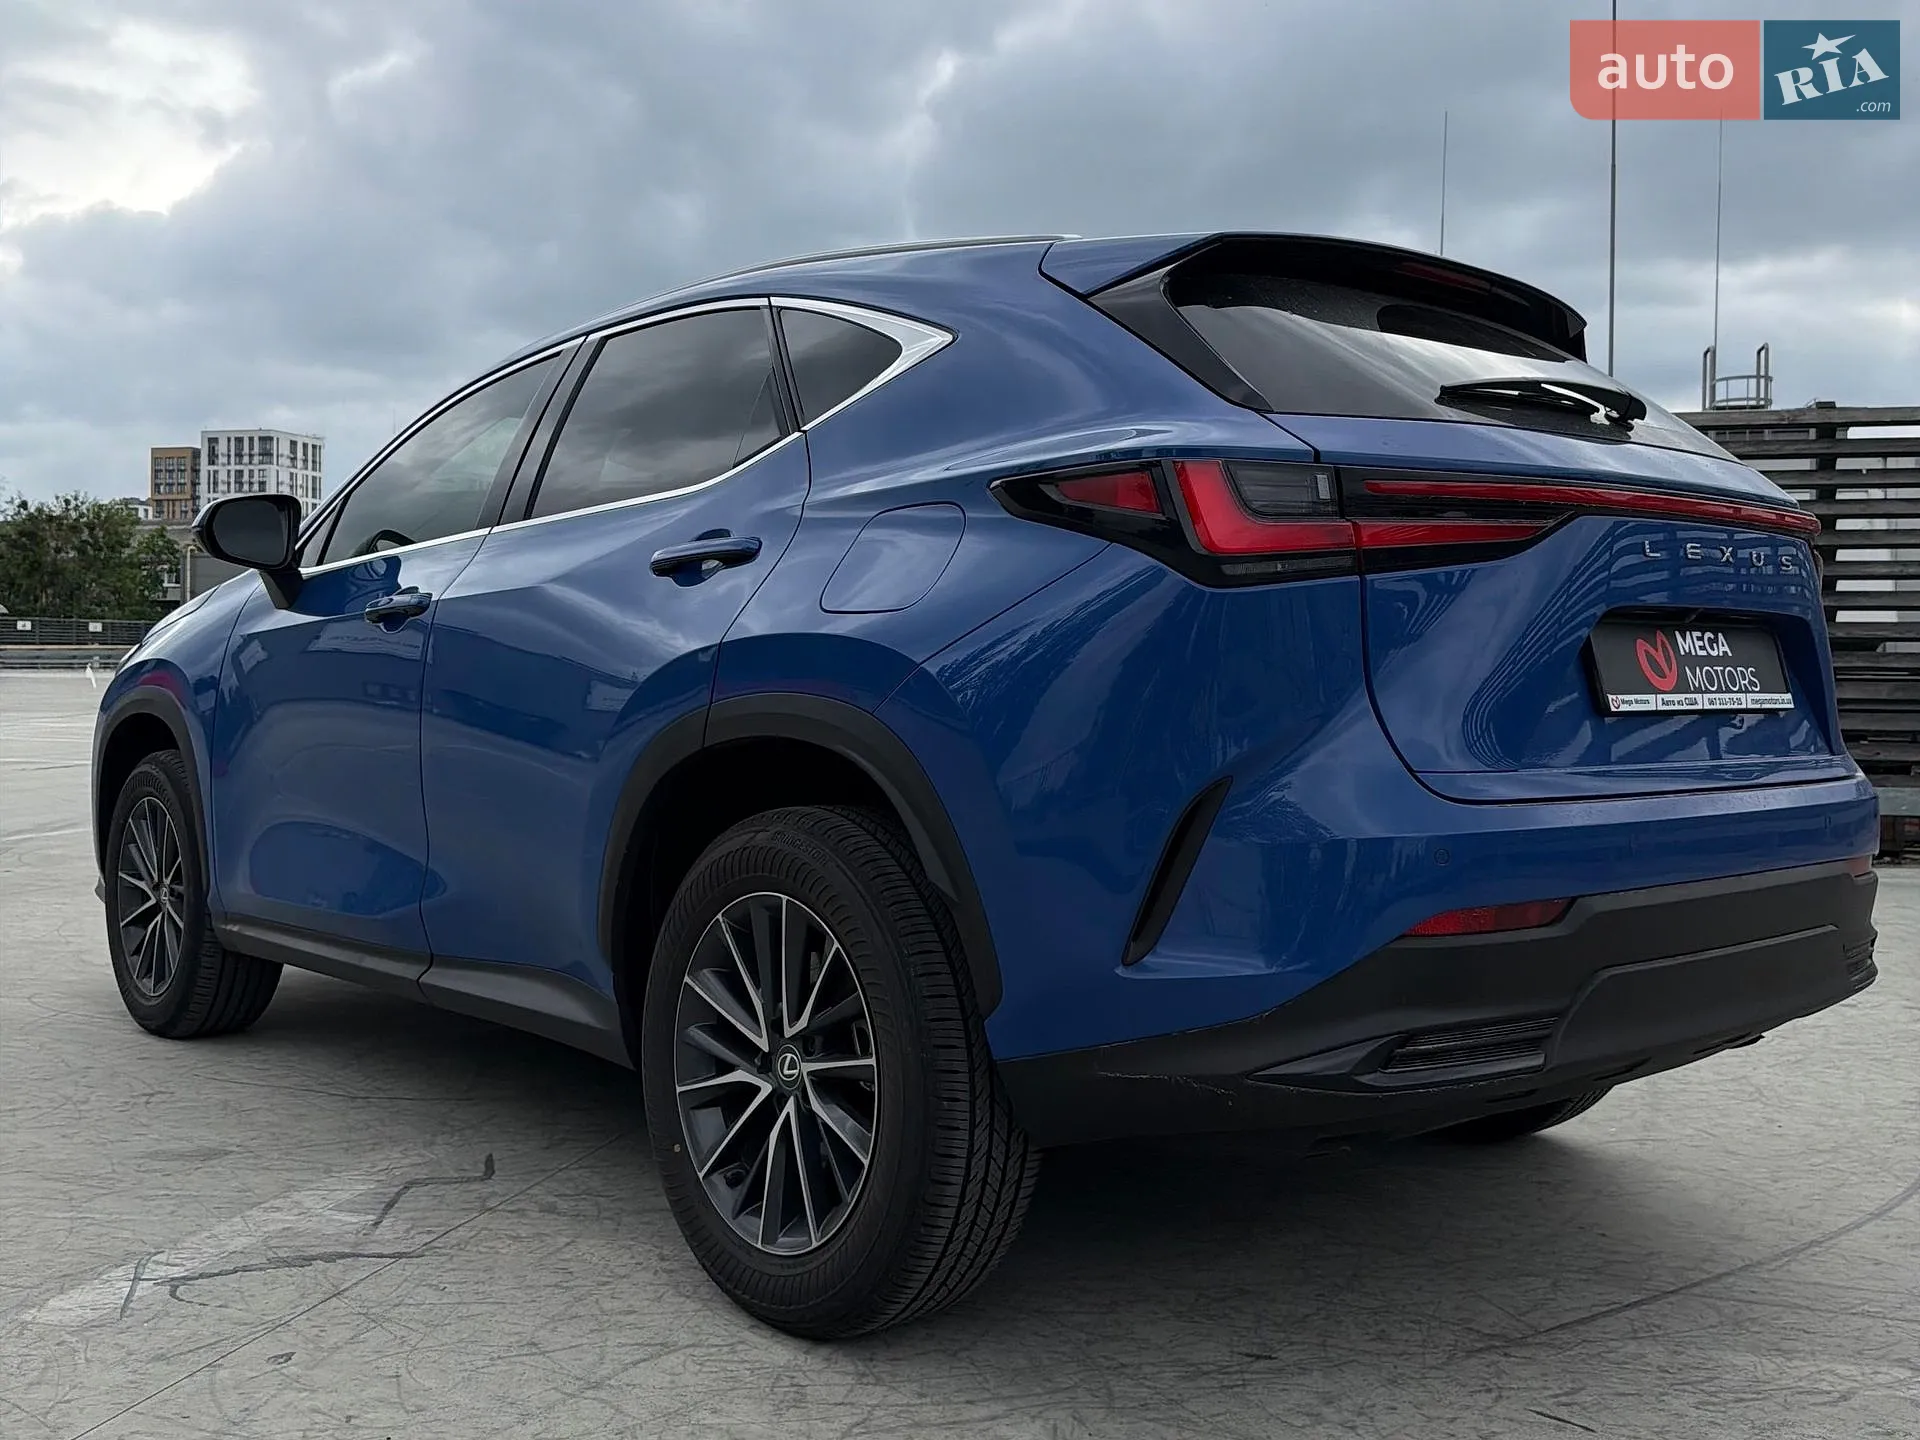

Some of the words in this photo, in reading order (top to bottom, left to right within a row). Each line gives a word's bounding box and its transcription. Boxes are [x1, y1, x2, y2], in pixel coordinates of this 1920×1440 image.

[1643, 540, 1793, 572] LEXUS
[1674, 629, 1733, 657] MEGA
[1685, 665, 1761, 692] MOTORS
[1620, 697, 1634, 706] Mega
[1661, 697, 1675, 707] Авто
[1684, 697, 1699, 706] США
